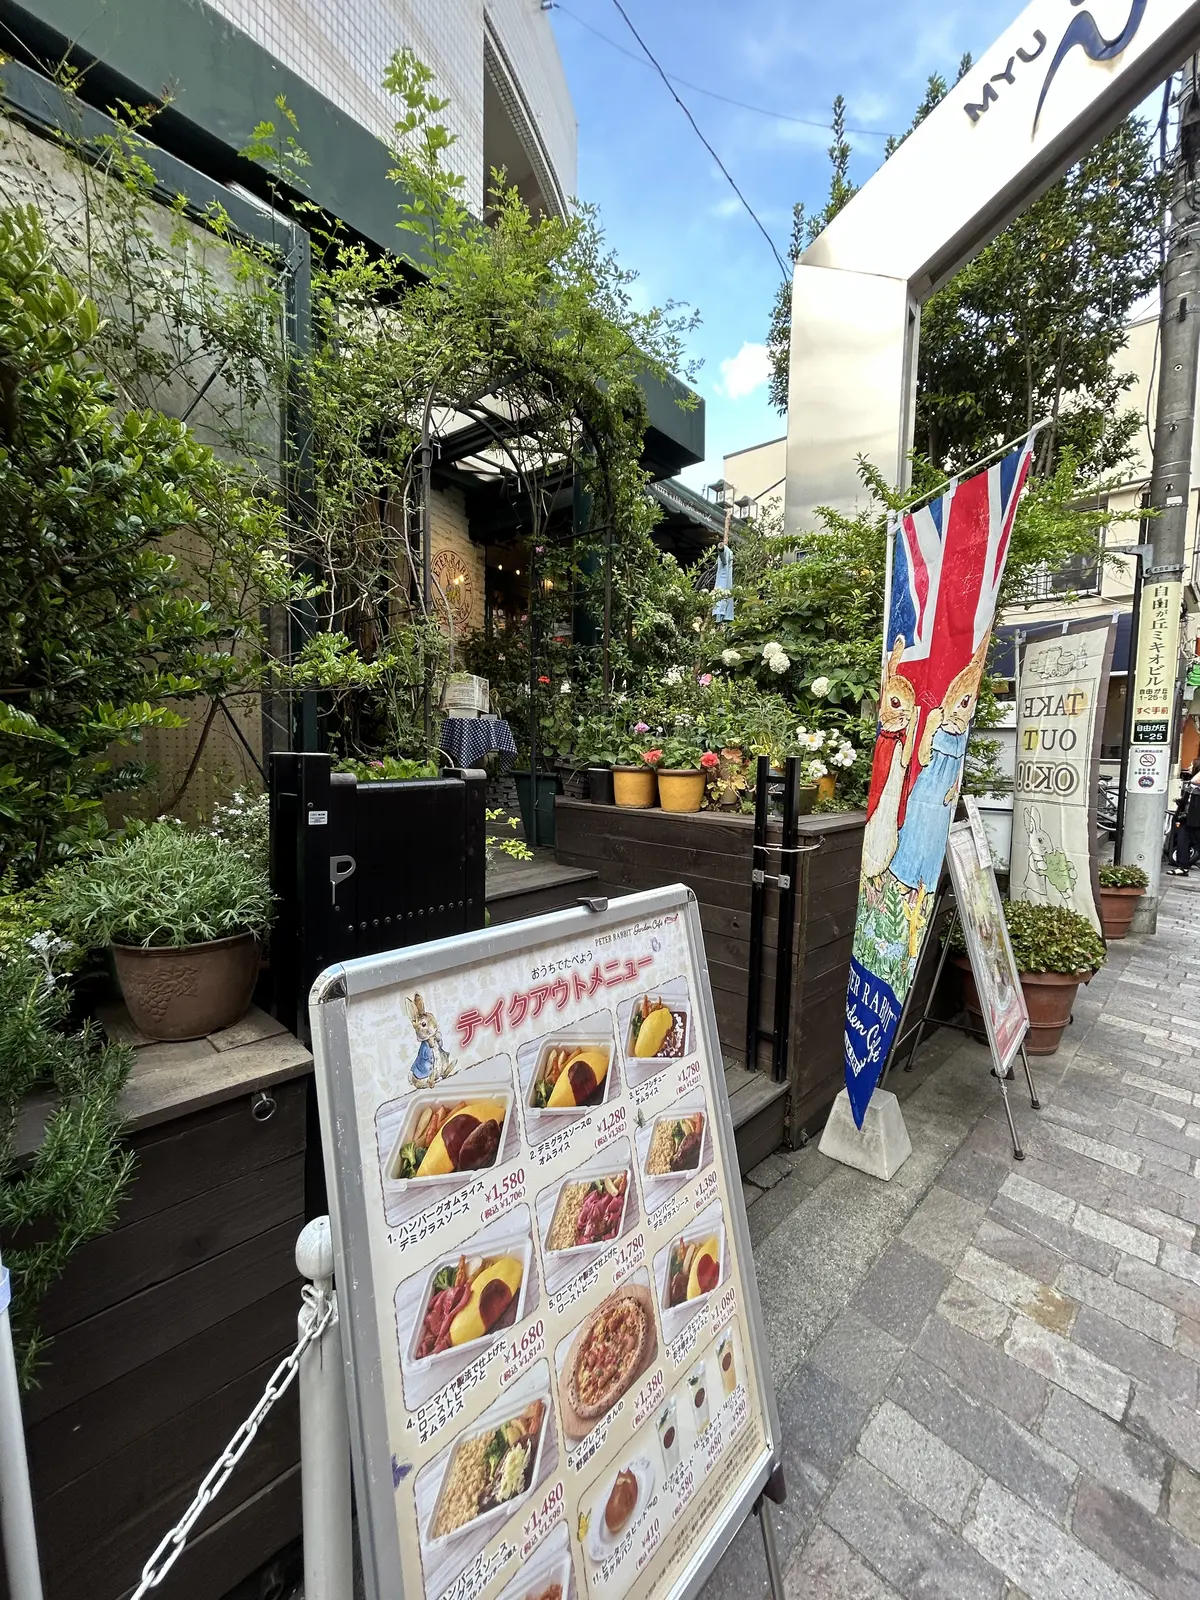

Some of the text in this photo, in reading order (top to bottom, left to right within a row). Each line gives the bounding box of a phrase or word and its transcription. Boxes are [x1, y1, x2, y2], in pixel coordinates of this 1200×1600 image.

[1145, 586, 1169, 687] 自由が丘ミキオビル
[1136, 706, 1168, 715] すぐ手前
[1136, 724, 1166, 732] 自由が丘
[595, 934, 612, 947] PETER
[613, 928, 633, 942] RABBIT
[633, 923, 652, 936] Garden
[531, 950, 593, 980] おうちでたべよう
[456, 956, 654, 1047] テイクアウトメニュー
[635, 1073, 667, 1096] ビーフシチュー
[677, 1060, 701, 1082] ¥1,780
[635, 1087, 659, 1106] オムライス
[597, 1106, 626, 1132] ¥1,280
[529, 1117, 592, 1160] 2. デミグラスソースの
[539, 1141, 571, 1166] オムライス
[484, 1168, 525, 1203] ¥1,580
[694, 1170, 717, 1197] ¥1,380
[387, 1180, 485, 1245] 1. ハンバーグオムライス
[480, 1186, 526, 1223] (税込 ¥1,706)
[652, 1196, 676, 1221] ハンバーグ
[653, 1196, 690, 1231] デミグラスソース
[400, 1202, 470, 1252] デミグラスソース
[614, 1233, 645, 1266] ¥1,780
[549, 1299, 556, 1309] 5.
[557, 1273, 599, 1314] ローストビーフ
[711, 1287, 735, 1321] ¥1,080
[503, 1319, 544, 1365] ¥1,680
[499, 1338, 545, 1386] (税込 ¥1,814)
[406, 1340, 507, 1430] 4. ローマイヤ製法で仕上げた
[418, 1369, 487, 1433] ローストビーフと
[634, 1369, 664, 1409] ¥1,380
[420, 1402, 464, 1444] オムライス
[576, 1401, 624, 1456] マグレガーさんの
[669, 1461, 684, 1482] アイス
[677, 1471, 694, 1499] ¥580
[523, 1481, 564, 1535] ¥1,480
[641, 1517, 660, 1549] ¥410
[592, 1573, 602, 1585] 11.
